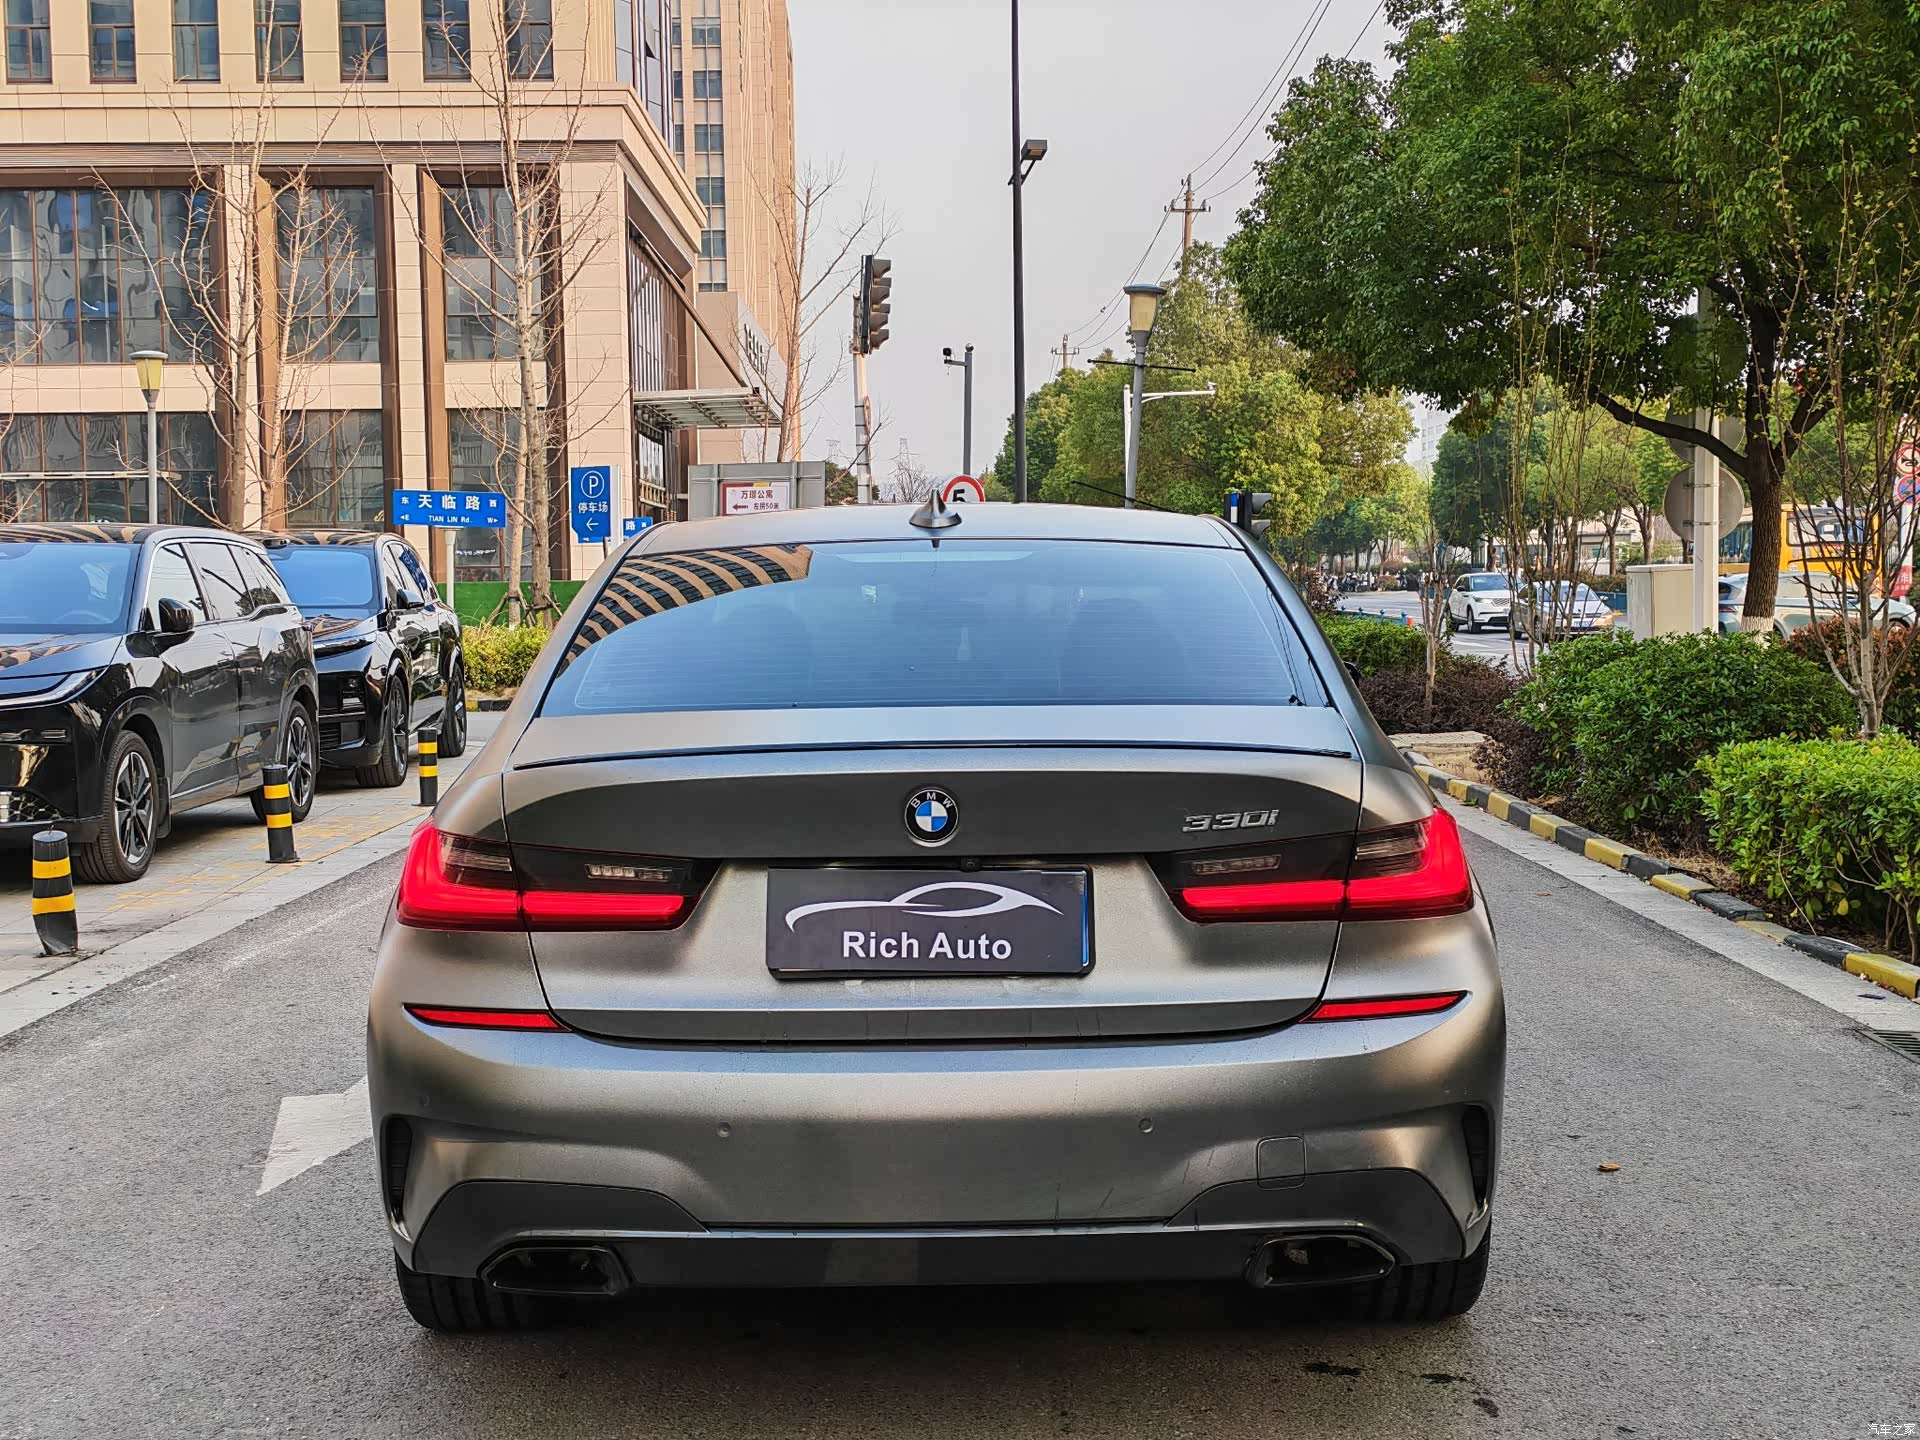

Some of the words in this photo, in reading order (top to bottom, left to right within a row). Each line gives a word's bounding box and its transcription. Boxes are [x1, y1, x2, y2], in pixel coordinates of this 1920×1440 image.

[589, 475, 599, 495] P
[401, 496, 409, 504] 东
[418, 494, 480, 510] 天临路
[578, 501, 608, 514] 停车场
[910, 792, 953, 809] BMW
[1182, 809, 1280, 832] 330i
[842, 931, 919, 959] Rich
[929, 932, 1012, 960] Auto
